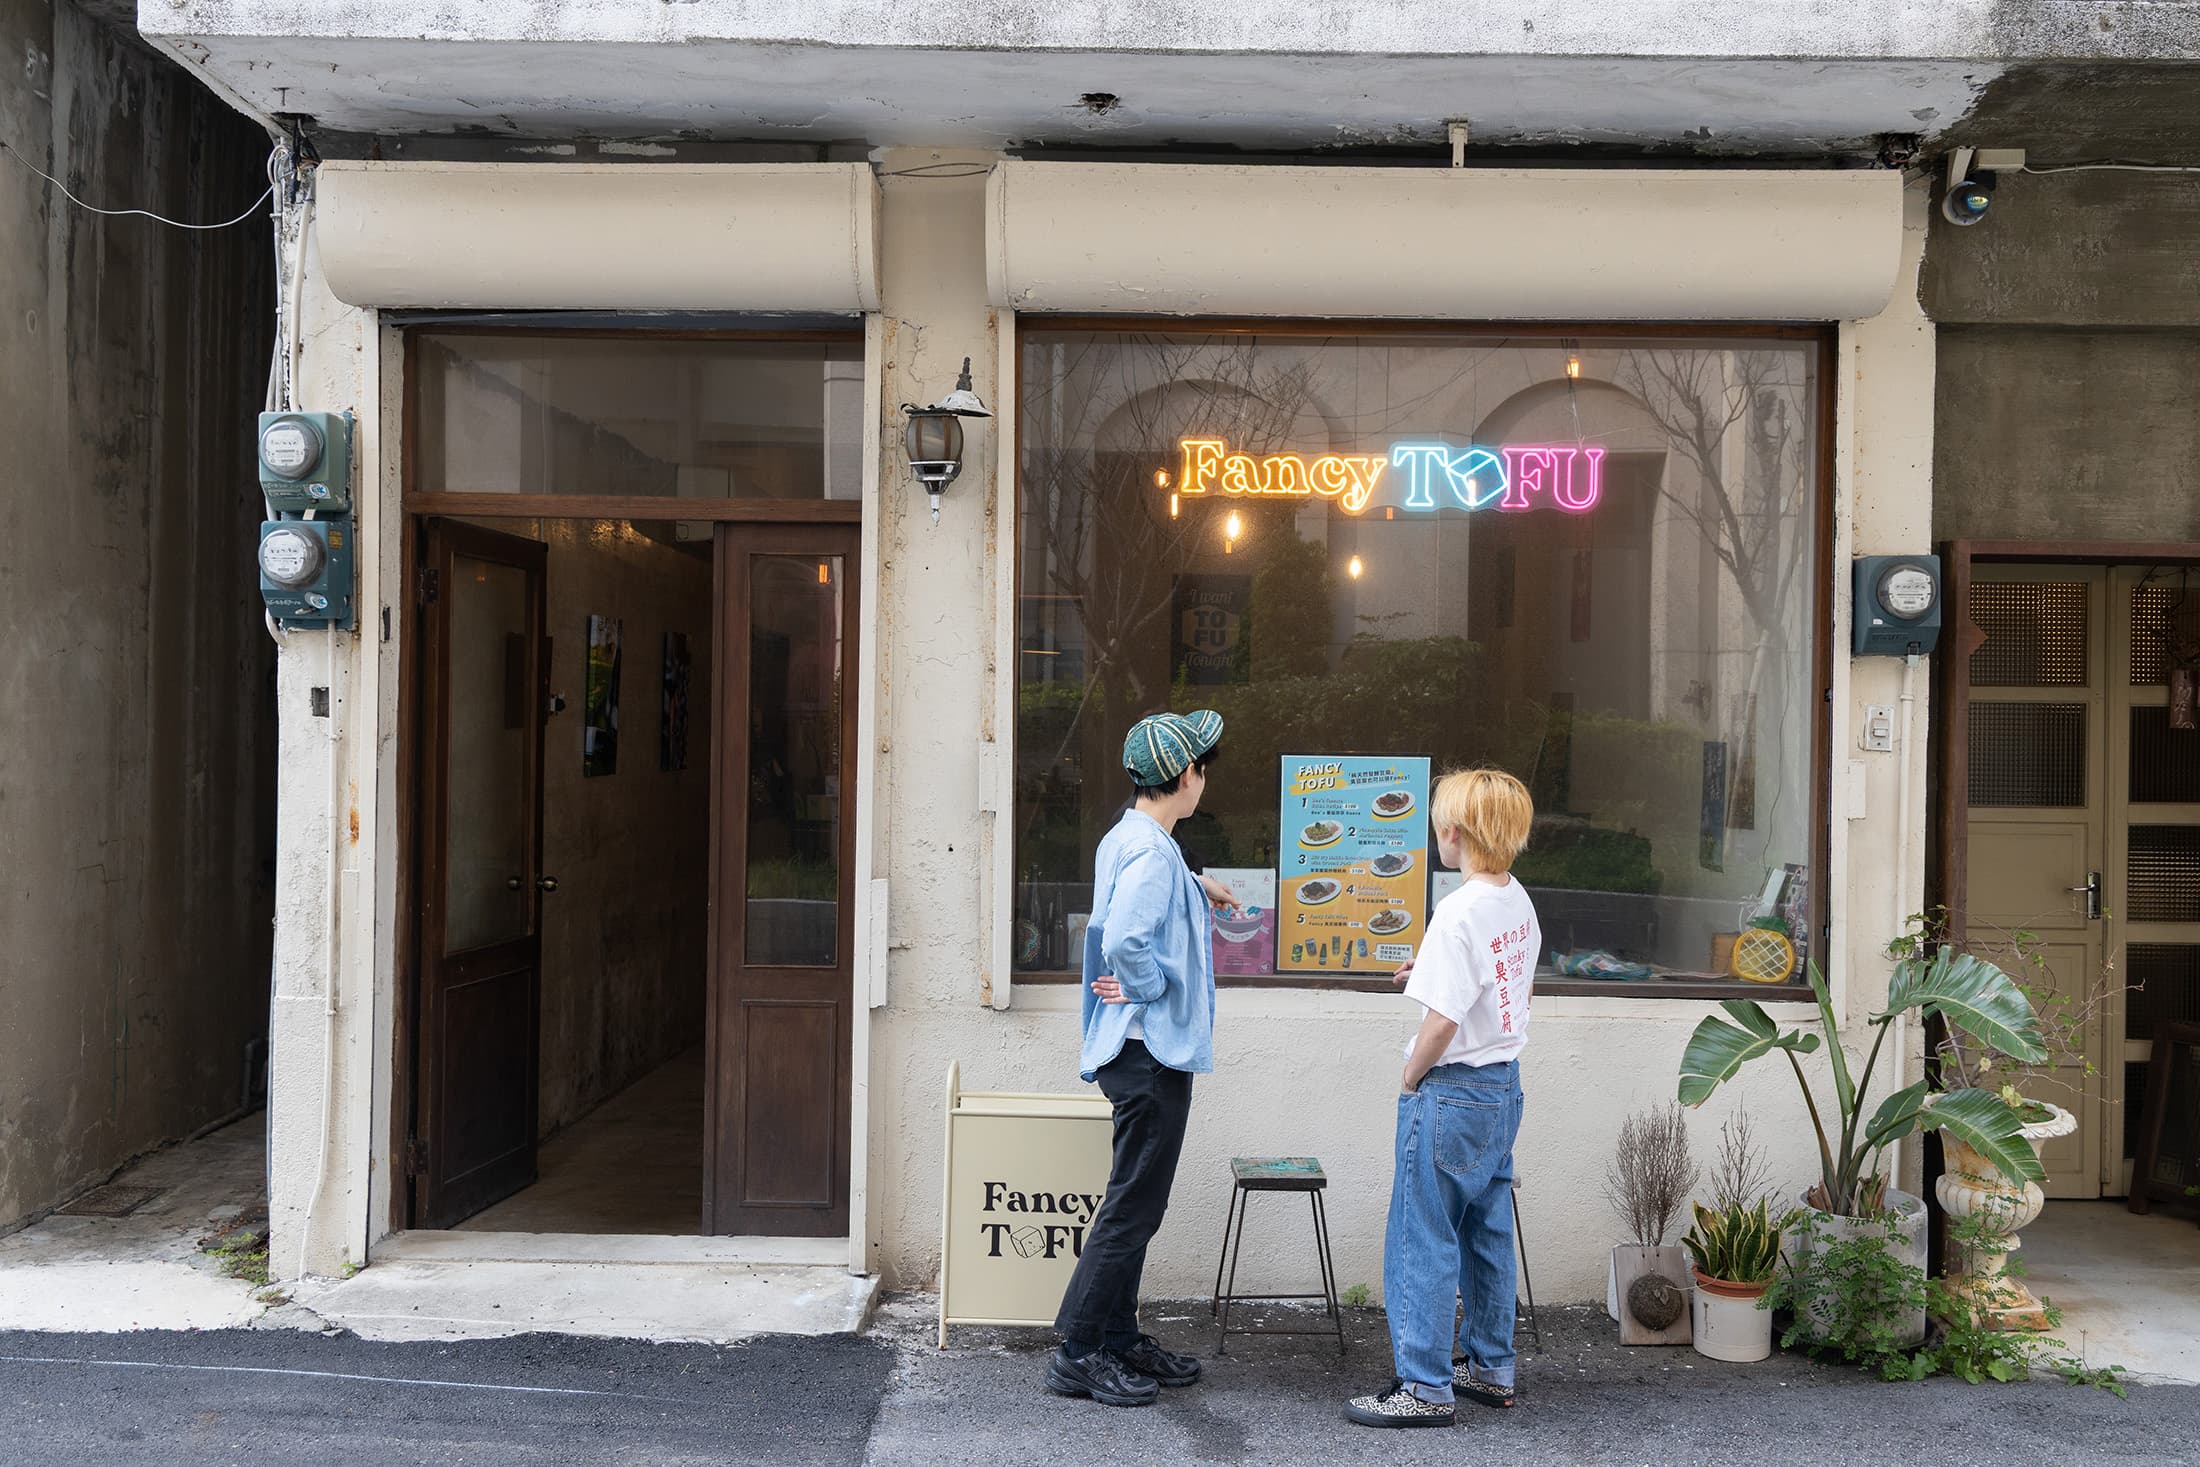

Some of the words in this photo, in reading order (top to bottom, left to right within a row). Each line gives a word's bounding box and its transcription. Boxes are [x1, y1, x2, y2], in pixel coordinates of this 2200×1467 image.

[1181, 439, 1387, 513] Fancy
[1298, 761, 1342, 776] FANCY
[1300, 777, 1336, 791] TOFU
[1302, 797, 1308, 808] 1
[1348, 826, 1356, 837] 2
[1298, 854, 1306, 865] 3
[1346, 884, 1355, 895] 4
[1296, 913, 1305, 924] 5
[1495, 960, 1512, 1034] 臭豆腐
[982, 1181, 1105, 1224] Fancy
